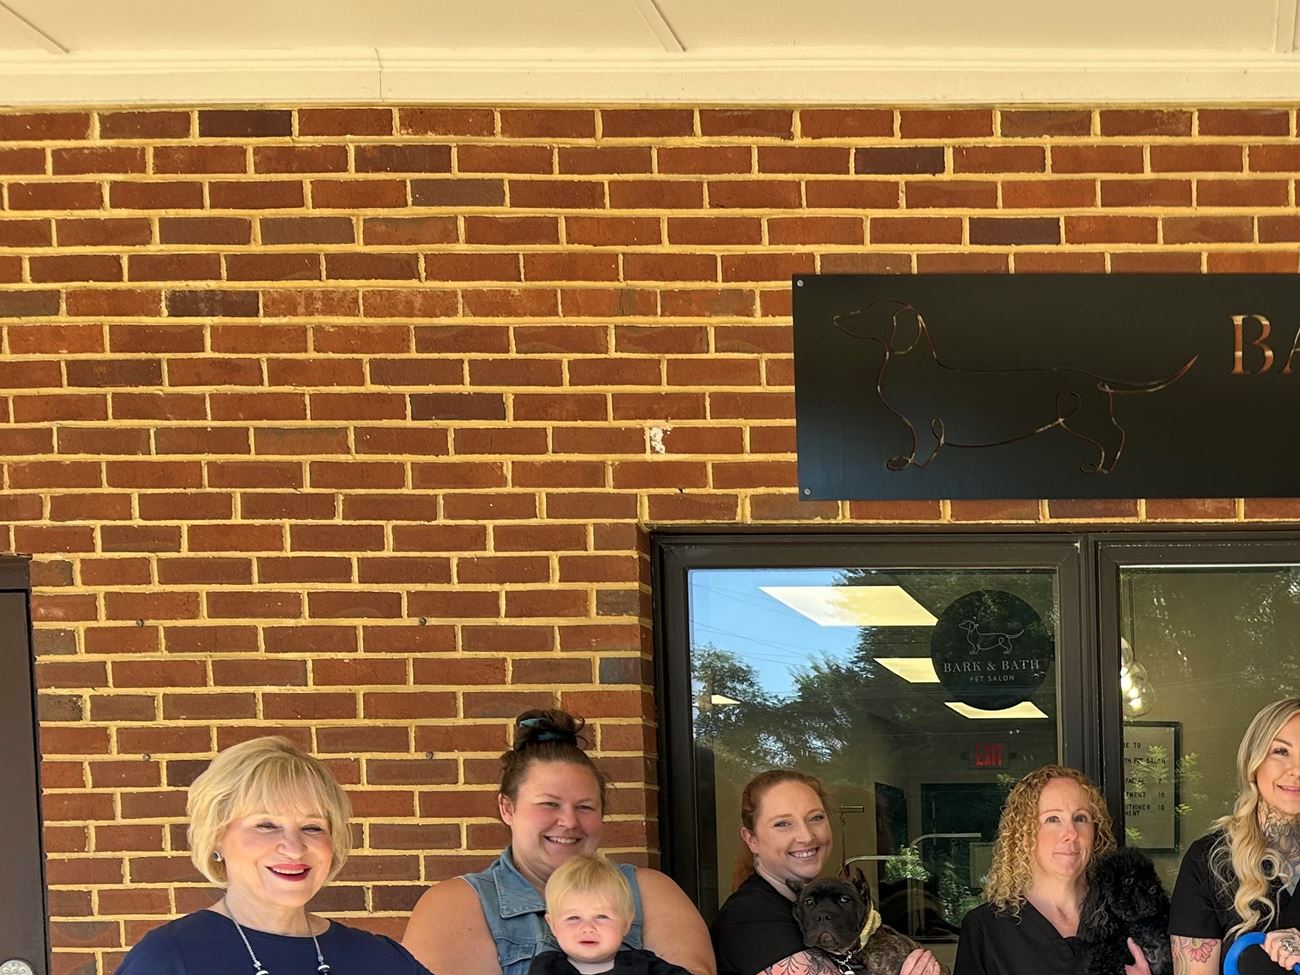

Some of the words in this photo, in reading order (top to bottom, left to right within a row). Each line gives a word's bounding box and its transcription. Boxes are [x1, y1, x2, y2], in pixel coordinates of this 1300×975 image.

[943, 661, 982, 673] BARK
[986, 660, 997, 672] &
[1002, 658, 1041, 671] BATH
[969, 674, 985, 683] PET
[987, 673, 1015, 682] SALON
[975, 743, 1003, 767] EXIT
